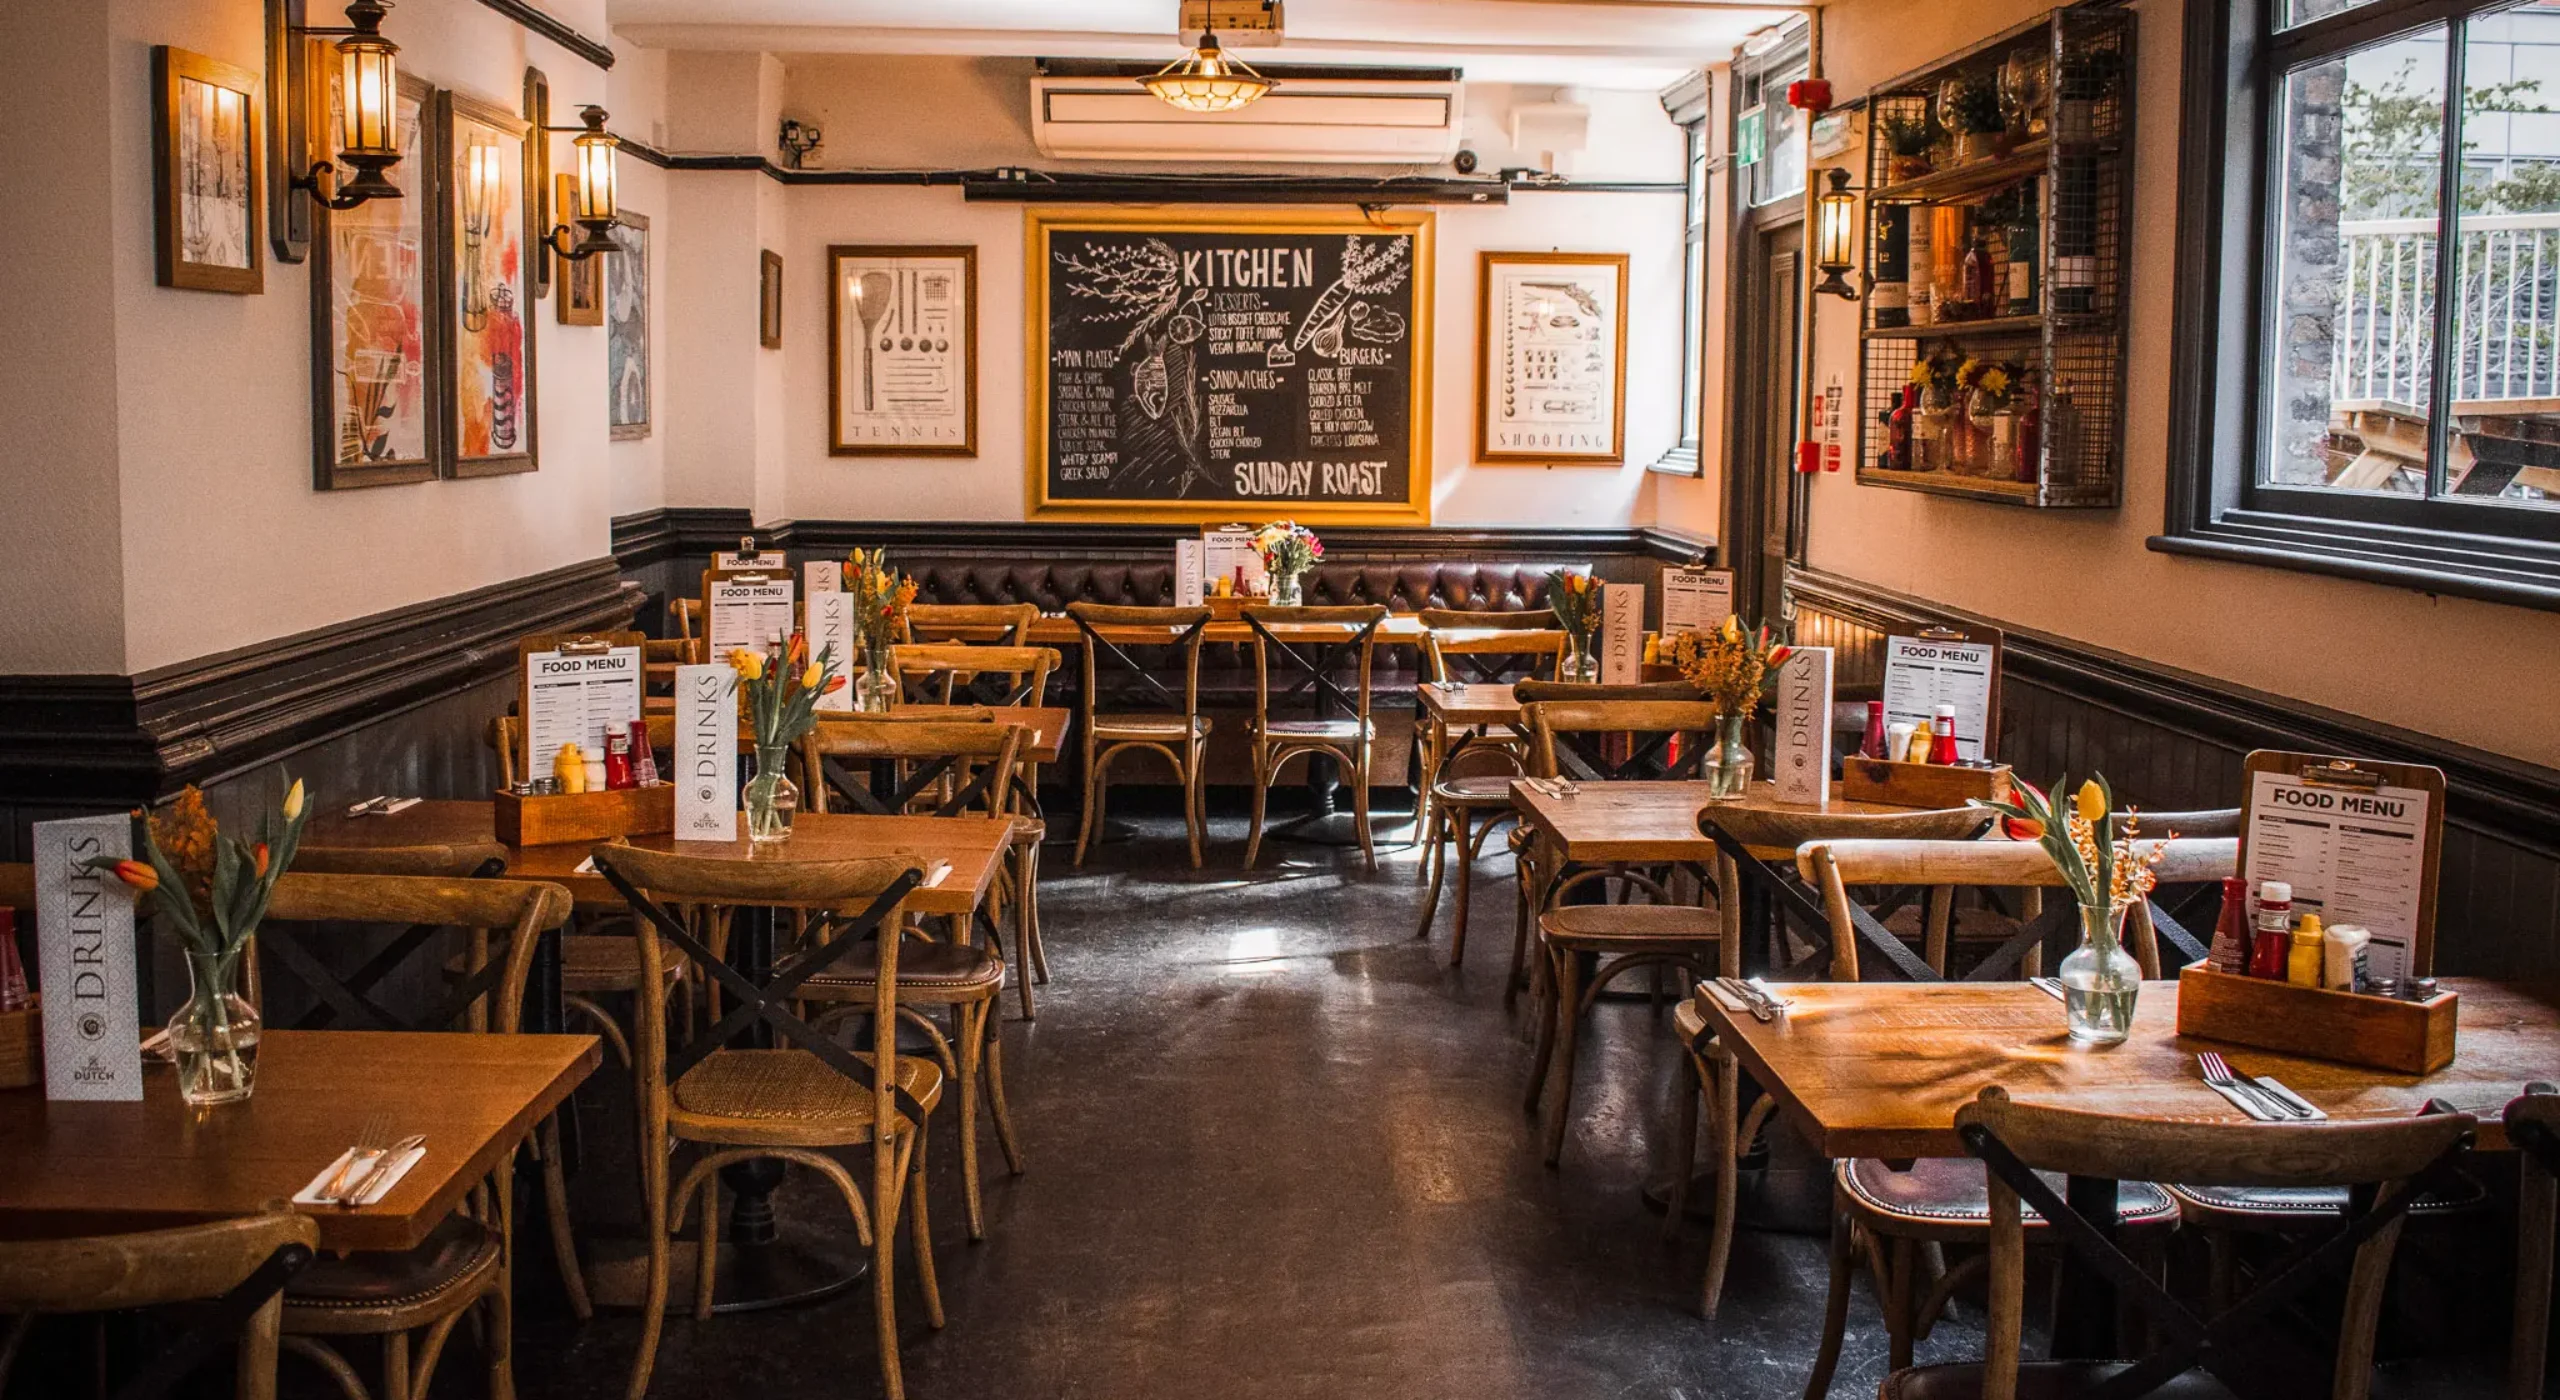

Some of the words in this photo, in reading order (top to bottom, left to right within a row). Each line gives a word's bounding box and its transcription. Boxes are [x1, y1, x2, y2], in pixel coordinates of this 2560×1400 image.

[1183, 248, 1313, 288] KITCHEN
[1208, 327, 1233, 341] STICKY
[1209, 342, 1233, 354] VEGAN
[1074, 372, 1082, 384] &
[1083, 371, 1103, 384] CHIPS
[1308, 368, 1335, 381] CLASSIC
[1337, 367, 1353, 381] BEEF
[1085, 384, 1094, 399] &
[1308, 382, 1337, 395] BOURBON
[1338, 382, 1352, 394] BBQ
[1354, 381, 1373, 395] MELT
[1208, 393, 1235, 405] SAUSAGE
[1308, 395, 1335, 408] CHORIZO
[1336, 395, 1342, 406] &
[1344, 394, 1363, 406] FETA
[1208, 405, 1249, 415] MOZZARELLA
[1309, 408, 1333, 420] GRILLED
[1334, 407, 1364, 420] CHICKEN
[1058, 414, 1080, 427] STEAK
[1080, 414, 1089, 426] &
[1104, 414, 1117, 427] PIE
[1209, 415, 1221, 427] BLT
[1309, 421, 1322, 433] THE
[1324, 420, 1340, 433] HOLY
[1357, 419, 1375, 432] COW
[852, 426, 957, 437] TENNIS
[1058, 428, 1087, 439] CHICKEN
[1209, 427, 1231, 438] VEGAN
[1233, 426, 1245, 437] BLT
[1209, 438, 1235, 449] CHICKEN
[1235, 437, 1262, 448] CHORIZO
[1499, 432, 1604, 448] SHOOTING
[1060, 453, 1090, 466] WHITBY
[1210, 449, 1231, 460] STEAK
[1060, 467, 1083, 480] GREEK
[1085, 465, 1110, 480] SALAD
[1234, 461, 1313, 496] SUNDAY
[1322, 461, 1388, 495] ROAST
[1672, 575, 1697, 584] FOOD
[1699, 576, 1724, 585] MENU
[720, 588, 750, 597] FOOD
[753, 587, 783, 596] MENU
[1614, 589, 1629, 657] DRINKS
[1900, 645, 1937, 658] FOOD
[1941, 649, 1980, 663] MENU
[541, 660, 582, 674] FOOD
[586, 657, 626, 671] MENU
[1792, 655, 1811, 747] DRINKS
[697, 675, 718, 777] DRINKS
[2273, 788, 2334, 809] FOOD
[2340, 795, 2405, 818] MENU
[69, 836, 105, 999] DRINKS
[74, 1071, 115, 1081] DUTCH
